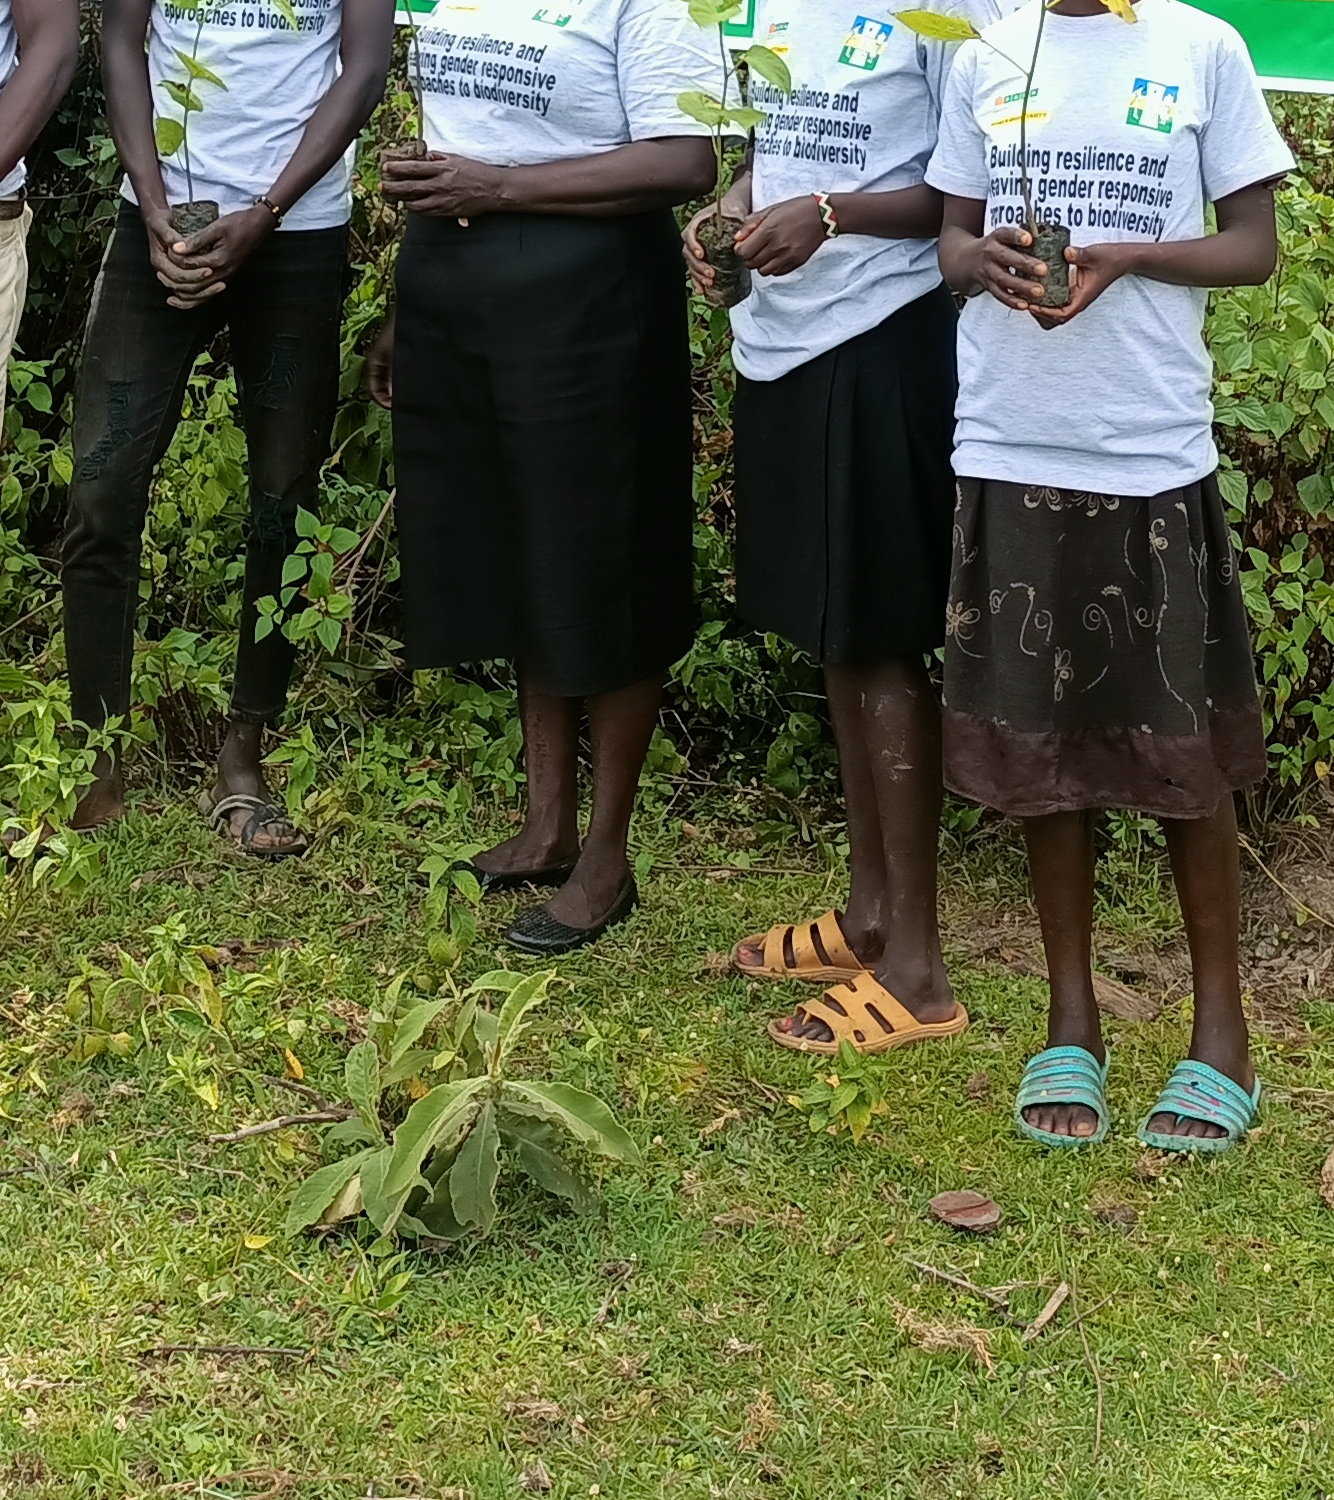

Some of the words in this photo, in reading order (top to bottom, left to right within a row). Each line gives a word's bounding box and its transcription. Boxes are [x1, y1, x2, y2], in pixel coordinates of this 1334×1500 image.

[241, 8, 255, 28] to
[516, 43, 548, 64] and
[440, 53, 479, 76] gender
[481, 60, 557, 91] responsive
[459, 76, 471, 98] to
[473, 78, 551, 117] biodiversity
[831, 90, 860, 114] and
[802, 115, 872, 142] responsive
[793, 134, 867, 172] biodiversity
[1056, 145, 1135, 173] resilience
[1139, 154, 1169, 179] and
[990, 171, 1033, 200] eaving
[1038, 173, 1095, 201] gender
[1098, 179, 1173, 210] responsive
[1067, 202, 1083, 228] to
[1088, 202, 1166, 243] biodiversity
